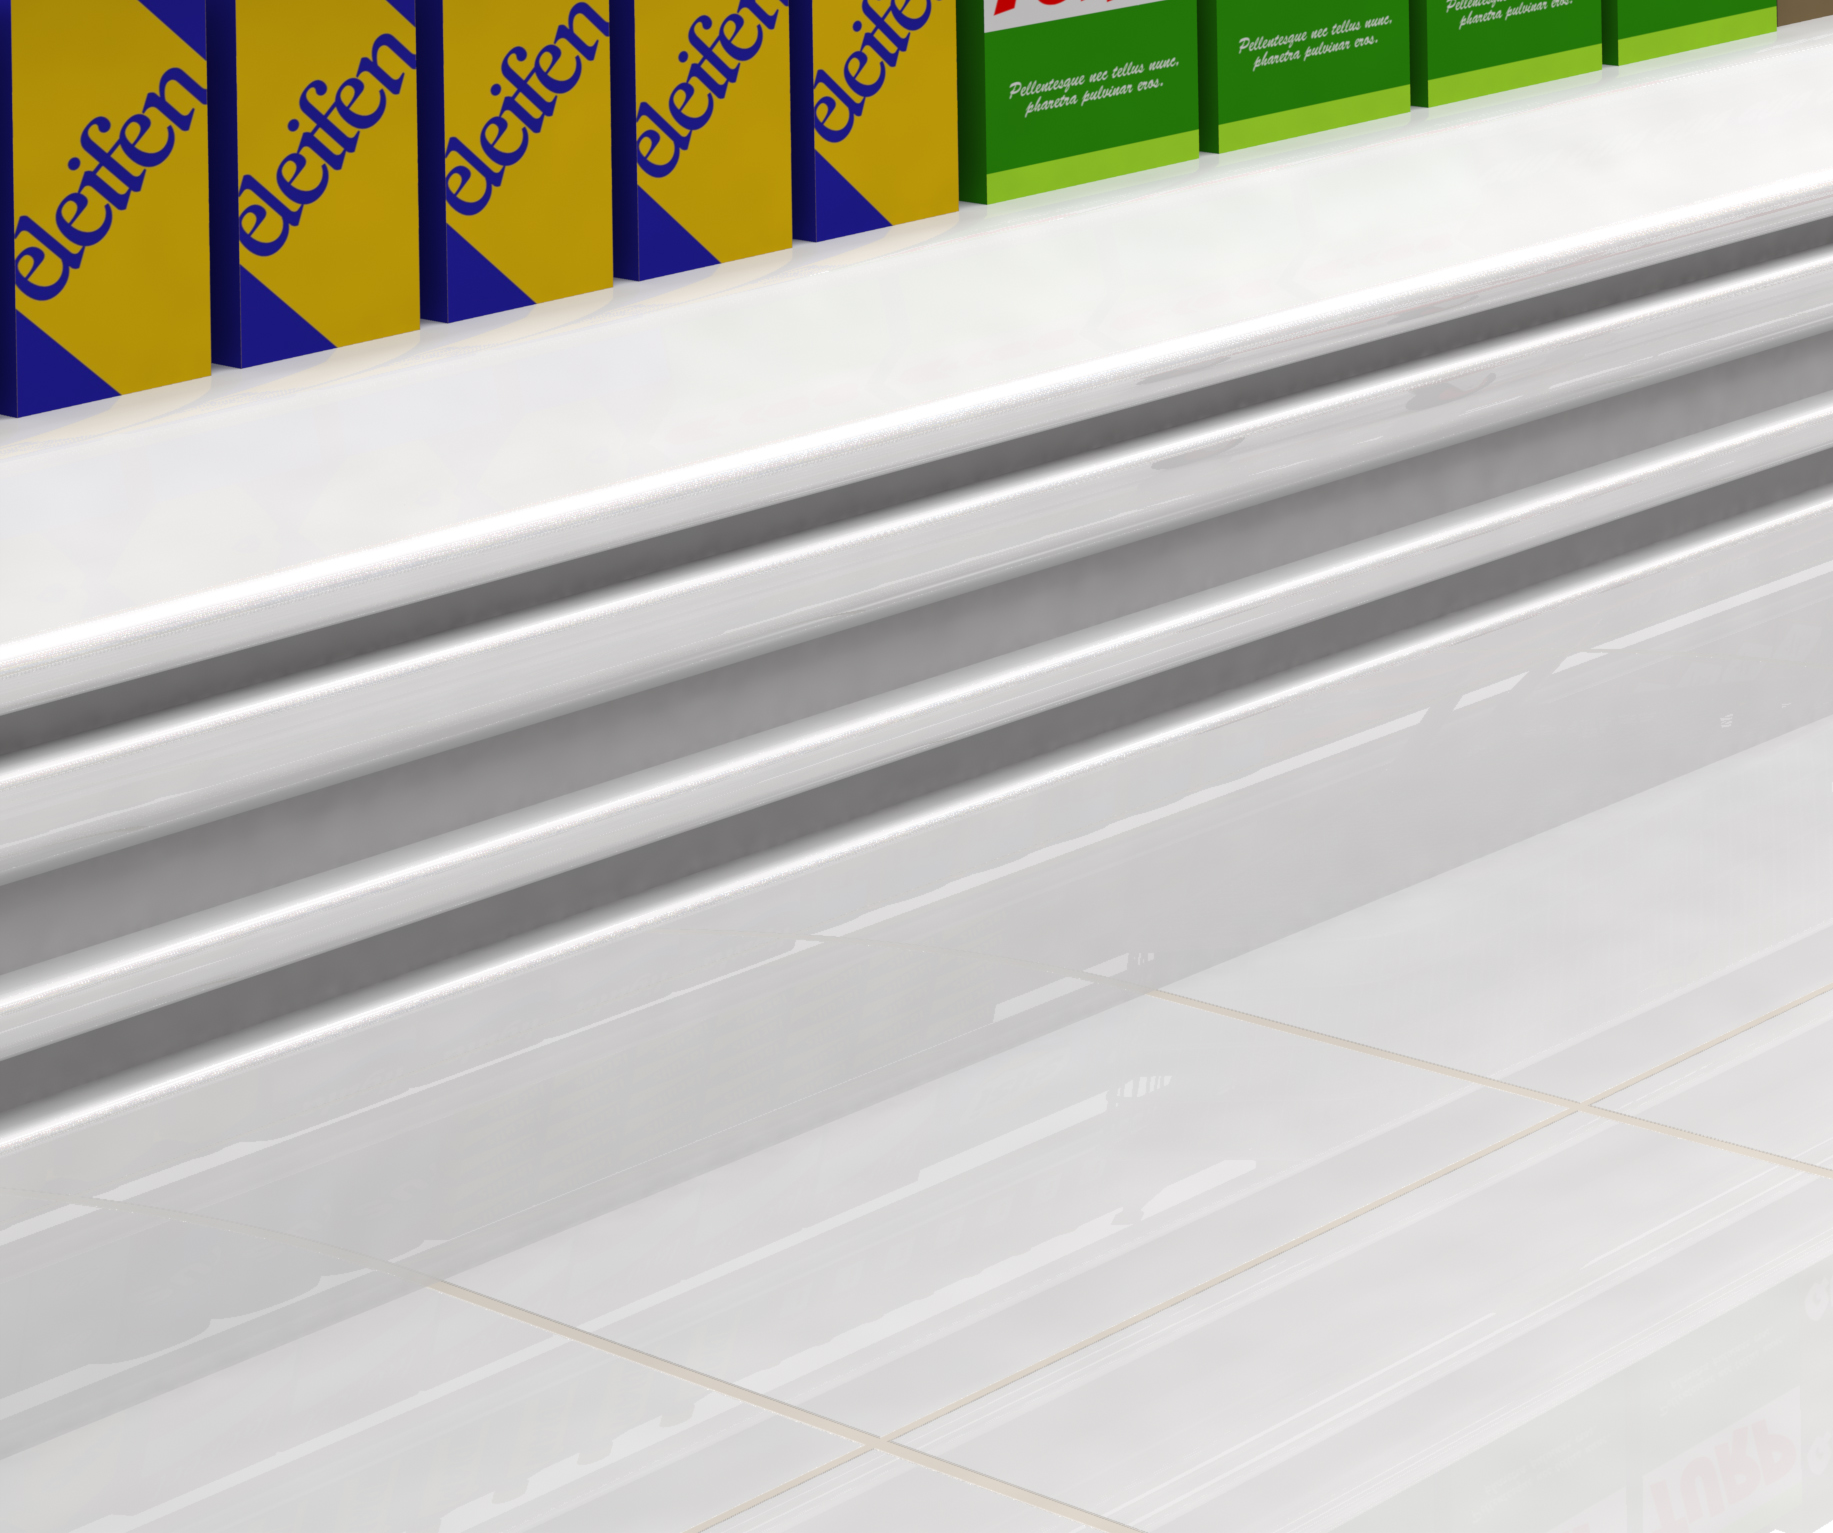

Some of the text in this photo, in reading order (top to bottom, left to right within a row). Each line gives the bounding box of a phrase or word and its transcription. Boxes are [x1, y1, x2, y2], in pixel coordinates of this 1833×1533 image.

[1009, 57, 1179, 99] Pellentesque nec tellus nunc,
[1025, 78, 1164, 118] pharetra pulvinar eros.
